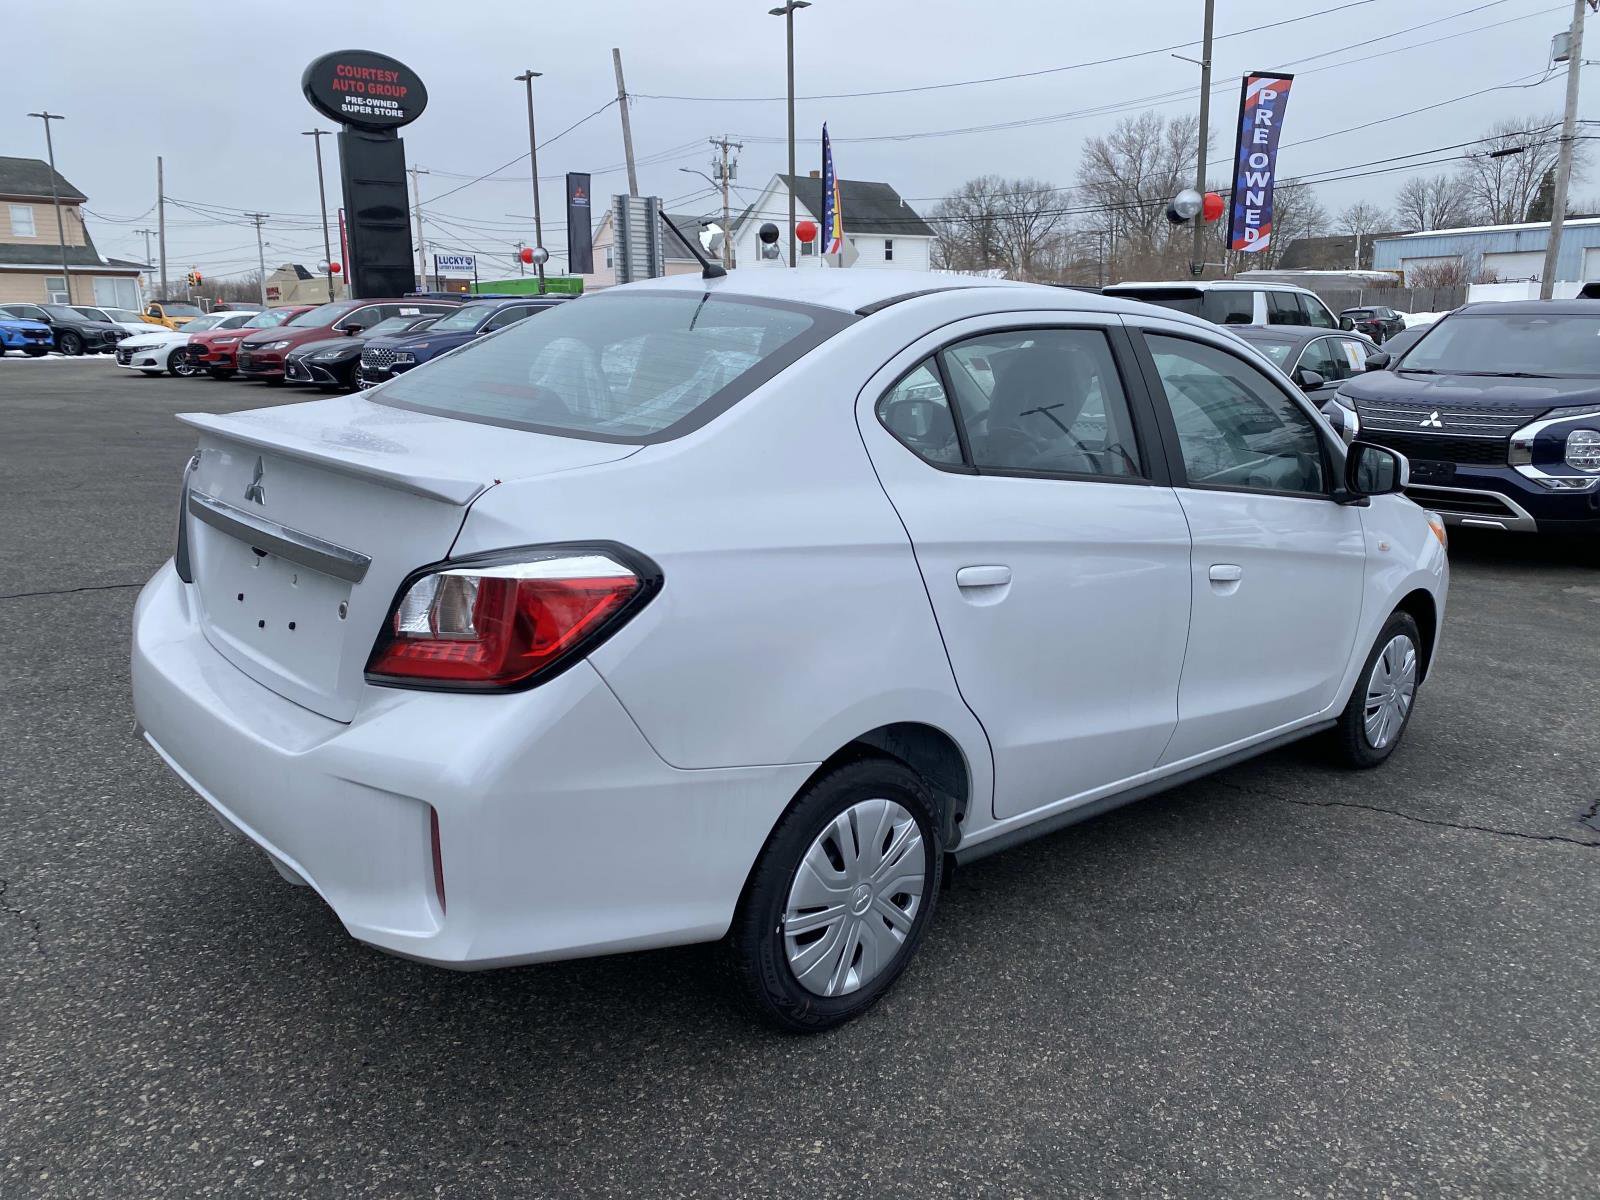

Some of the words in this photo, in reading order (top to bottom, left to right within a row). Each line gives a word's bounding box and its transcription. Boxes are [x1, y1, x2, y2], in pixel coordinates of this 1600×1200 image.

[336, 65, 398, 82] COURTESY
[332, 79, 365, 92] AUTO
[368, 83, 407, 97] GROUP
[341, 104, 372, 114] SUPER
[374, 107, 404, 117] STORE
[345, 96, 398, 108] PRE-OWNED
[1253, 89, 1277, 144] PRE
[1244, 152, 1270, 243] OWNED
[438, 256, 464, 265] LUCKY
